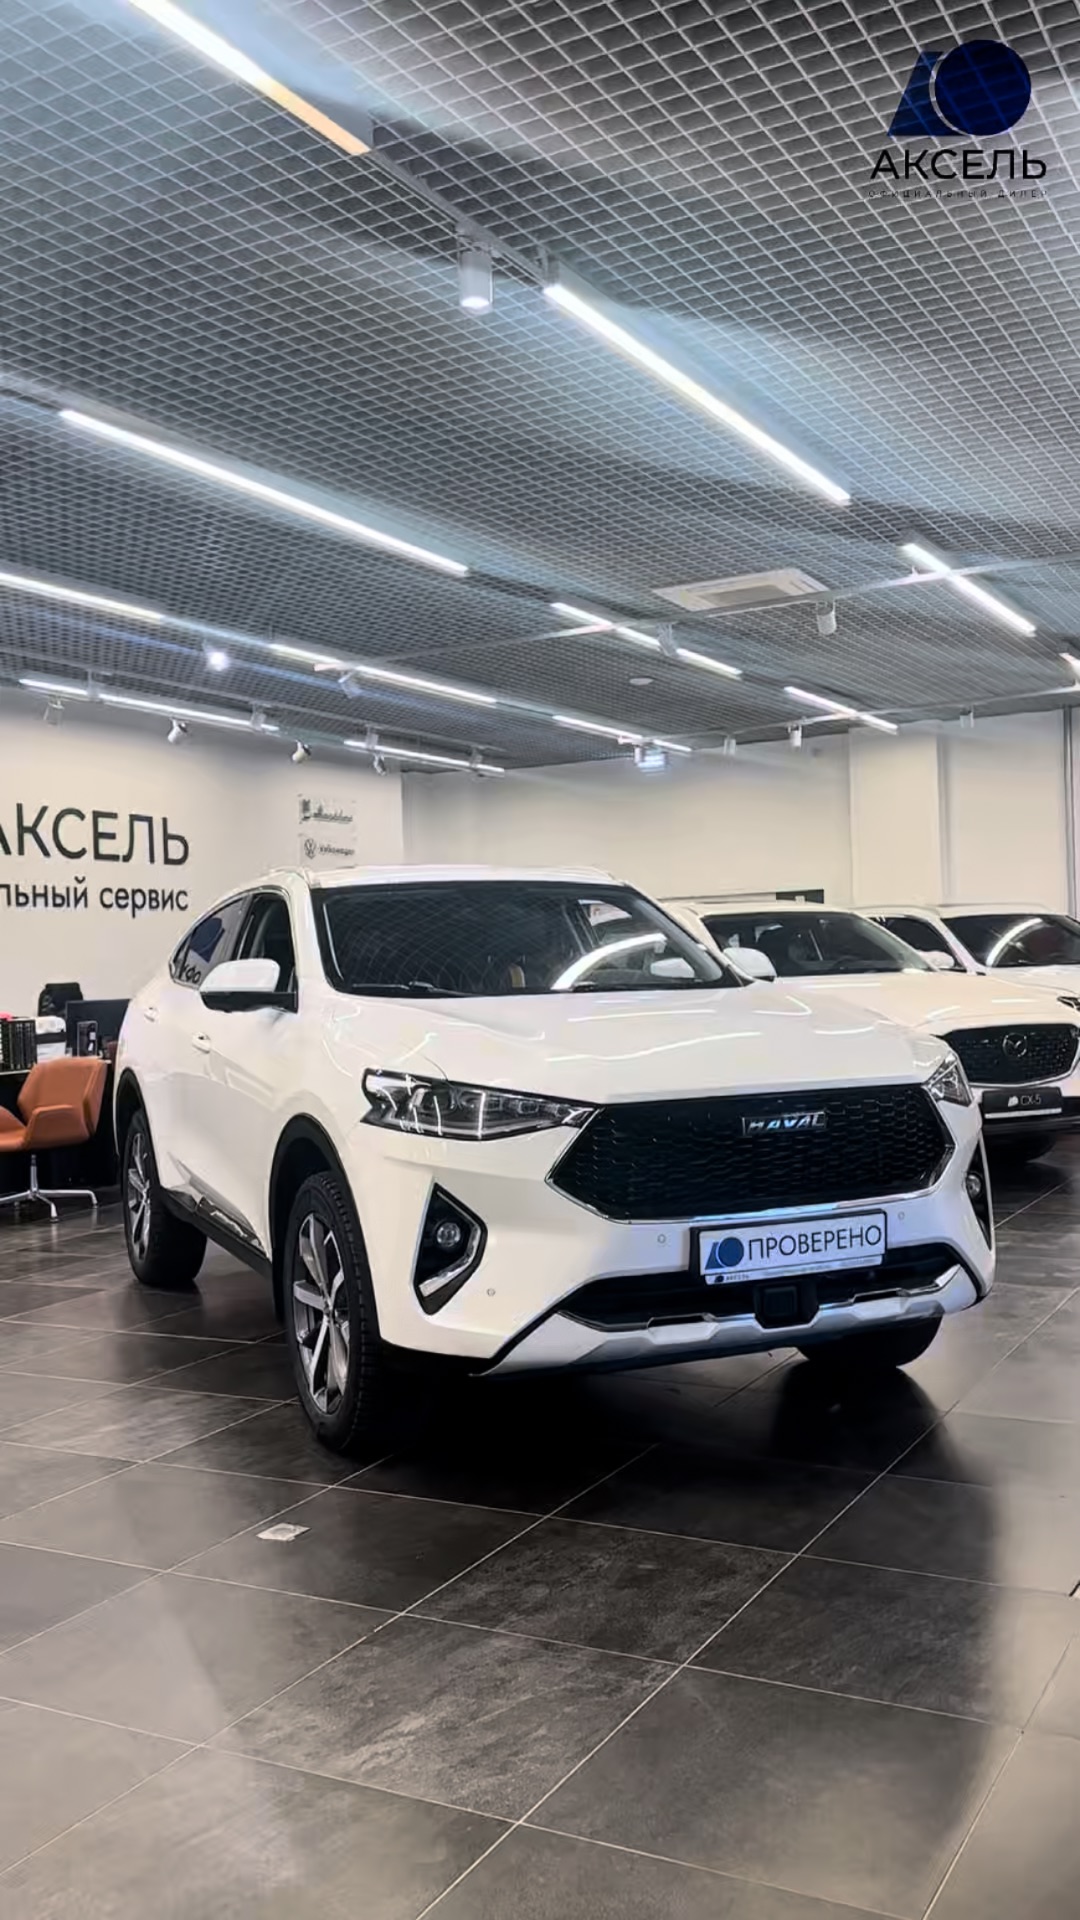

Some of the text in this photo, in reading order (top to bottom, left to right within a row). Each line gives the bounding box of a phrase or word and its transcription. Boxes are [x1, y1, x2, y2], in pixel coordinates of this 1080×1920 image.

[0, 803, 189, 865] КСЕЛЬ
[100, 887, 188, 918] сервис
[747, 1114, 825, 1133] HAVAL
[748, 1225, 882, 1260] ПРОВЕРЕНО
